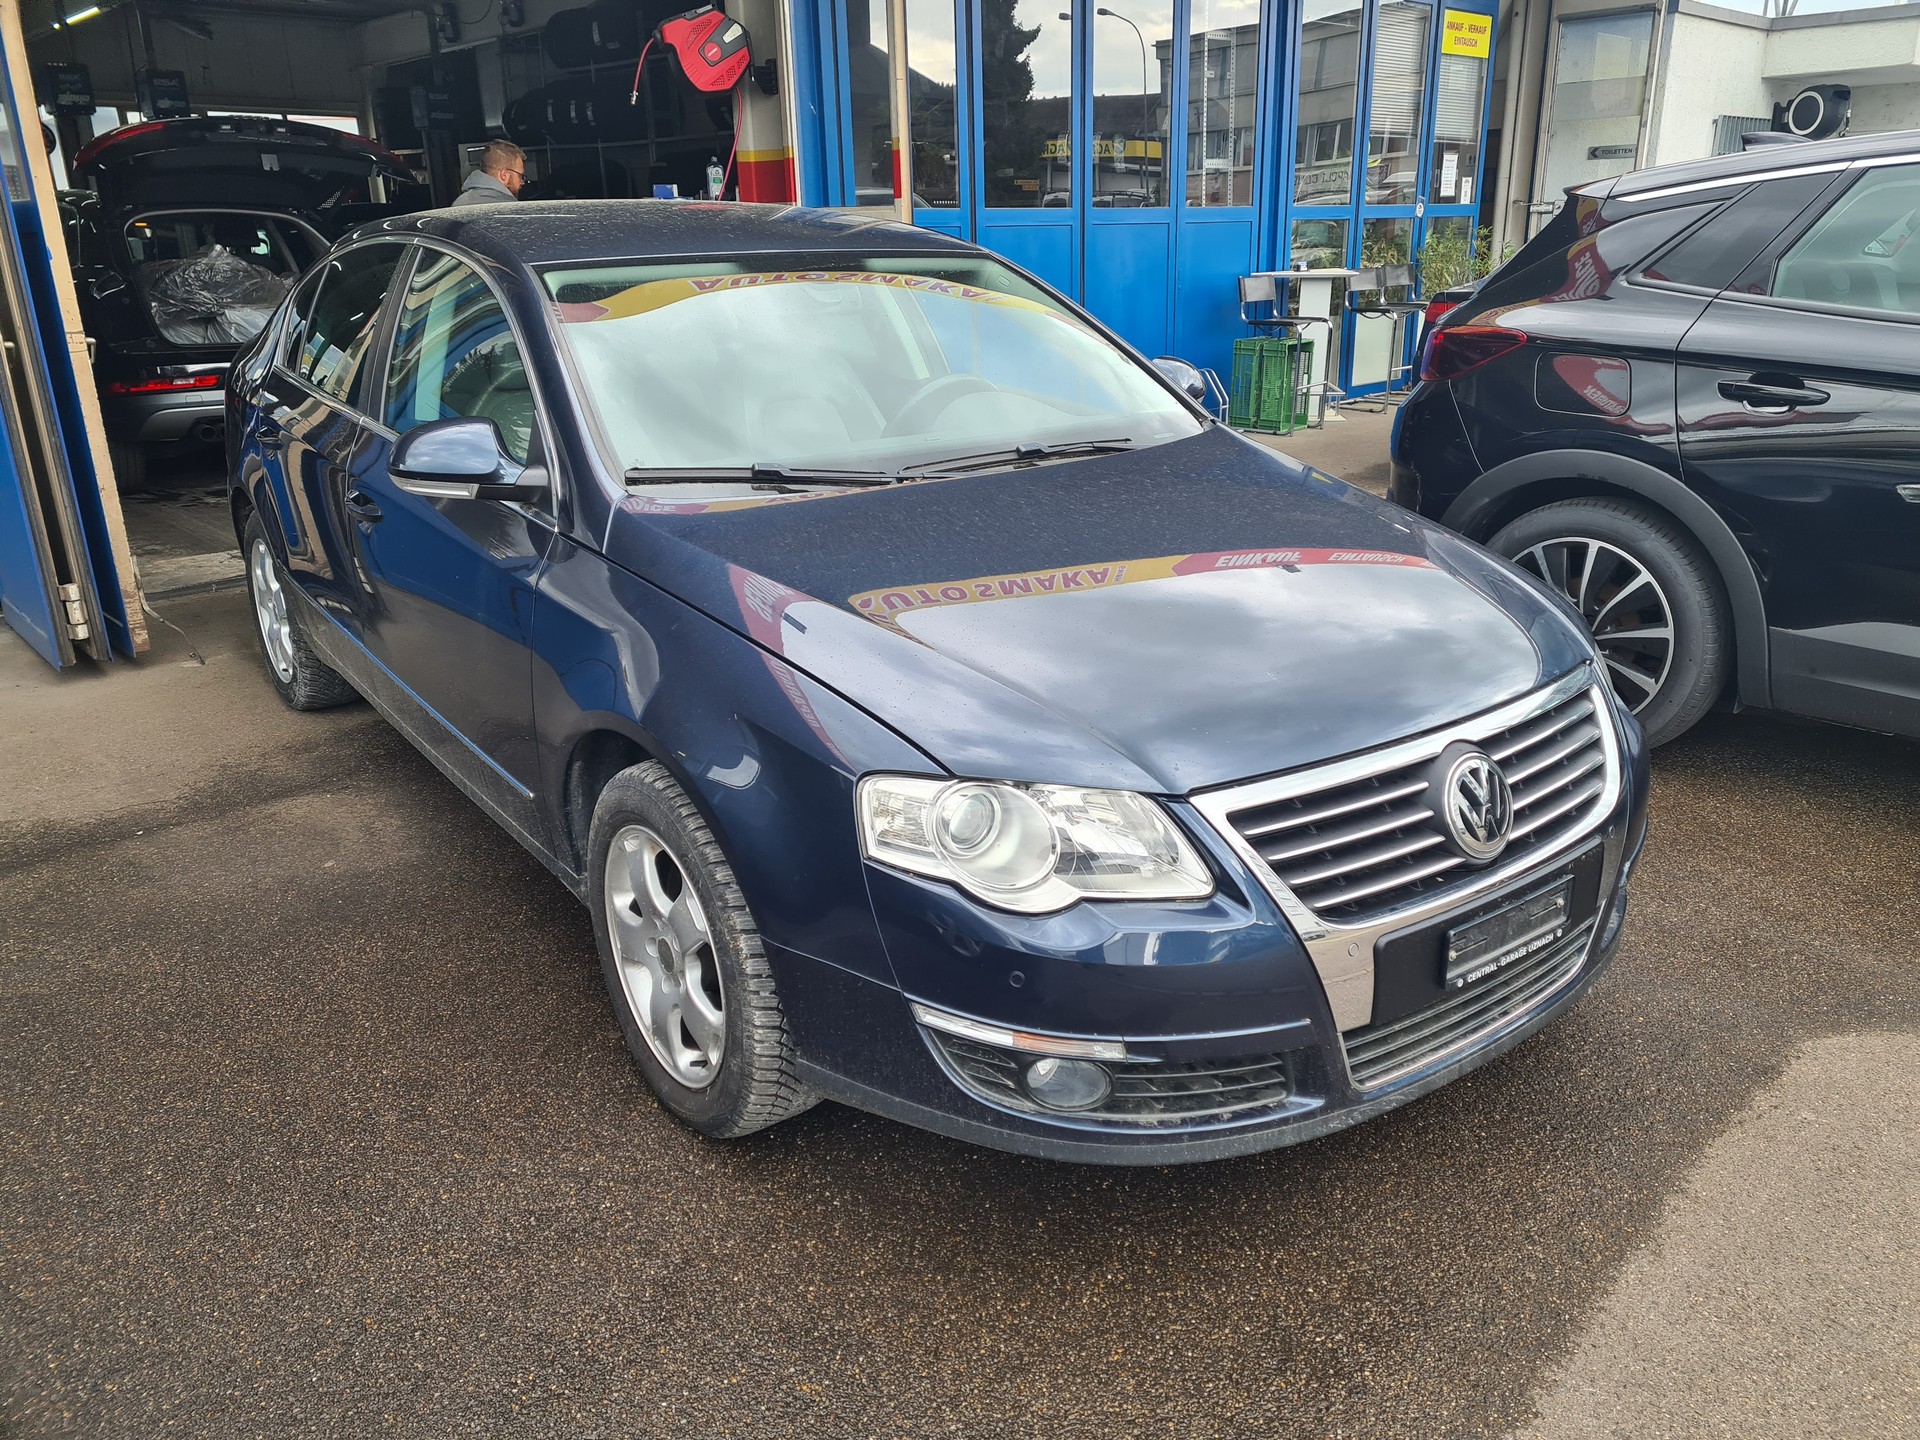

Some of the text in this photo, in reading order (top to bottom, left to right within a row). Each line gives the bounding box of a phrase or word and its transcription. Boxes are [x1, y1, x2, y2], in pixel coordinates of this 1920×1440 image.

[1446, 20, 1465, 32] ANKAUF
[1467, 23, 1488, 35] VERKAUF
[1454, 36, 1478, 48] EINTAUSCH
[1528, 932, 1554, 953] UZNACH
